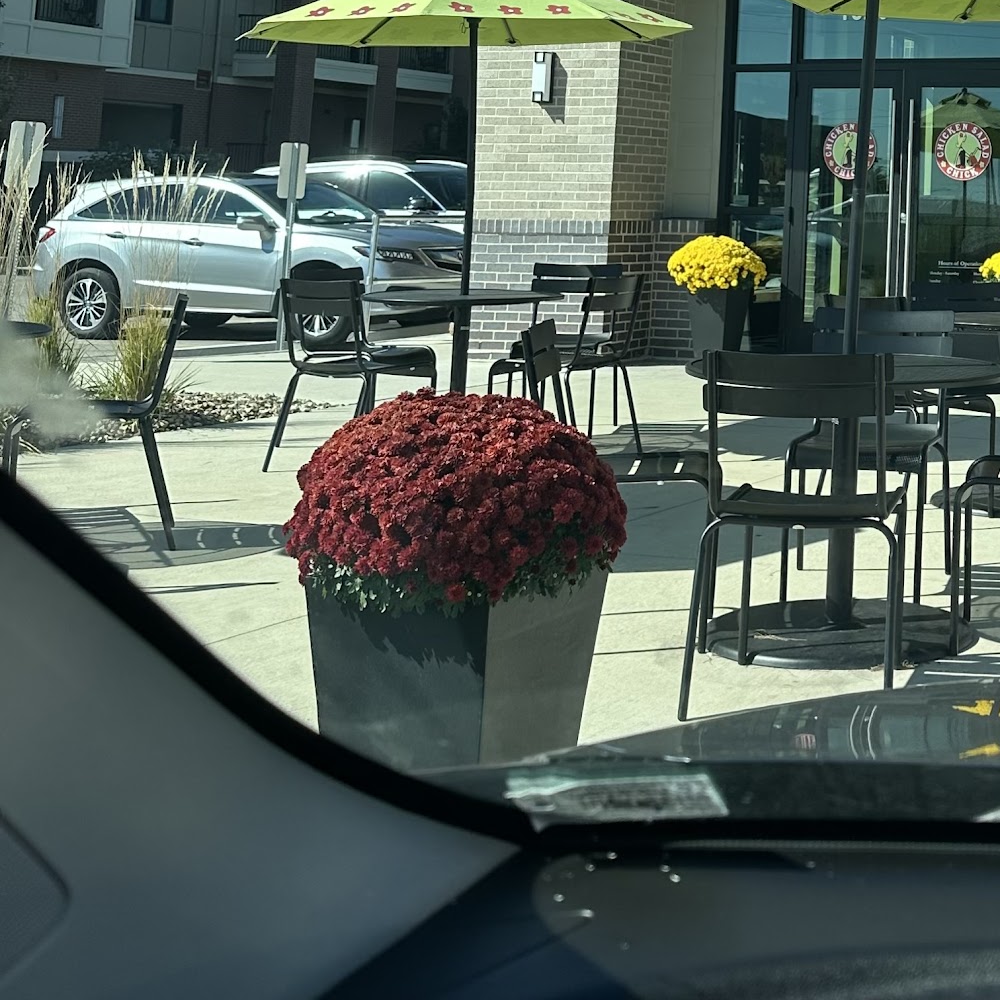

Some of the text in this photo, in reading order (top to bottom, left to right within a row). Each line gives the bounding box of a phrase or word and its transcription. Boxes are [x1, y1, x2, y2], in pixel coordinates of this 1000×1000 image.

[825, 123, 855, 157] CHICKEN
[937, 123, 990, 159] CHICKEN SALAD
[834, 166, 855, 178] CHIC
[947, 167, 979, 179] CHICK
